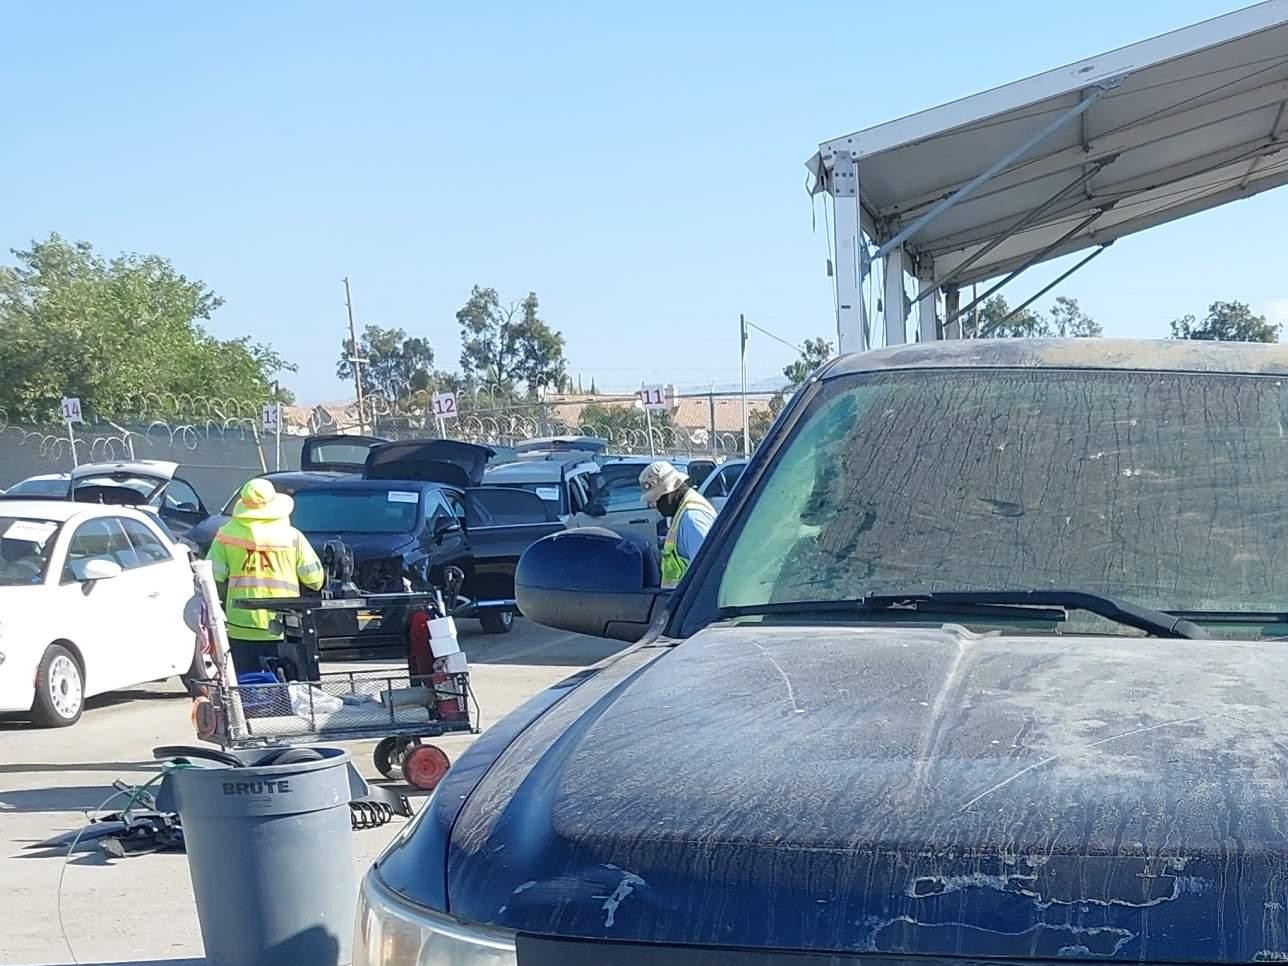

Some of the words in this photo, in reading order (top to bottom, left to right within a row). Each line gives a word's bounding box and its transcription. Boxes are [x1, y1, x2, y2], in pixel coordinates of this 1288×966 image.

[643, 389, 664, 405] 11
[63, 402, 80, 418] 14
[435, 398, 455, 414] 12
[222, 780, 290, 796] BRUTE
